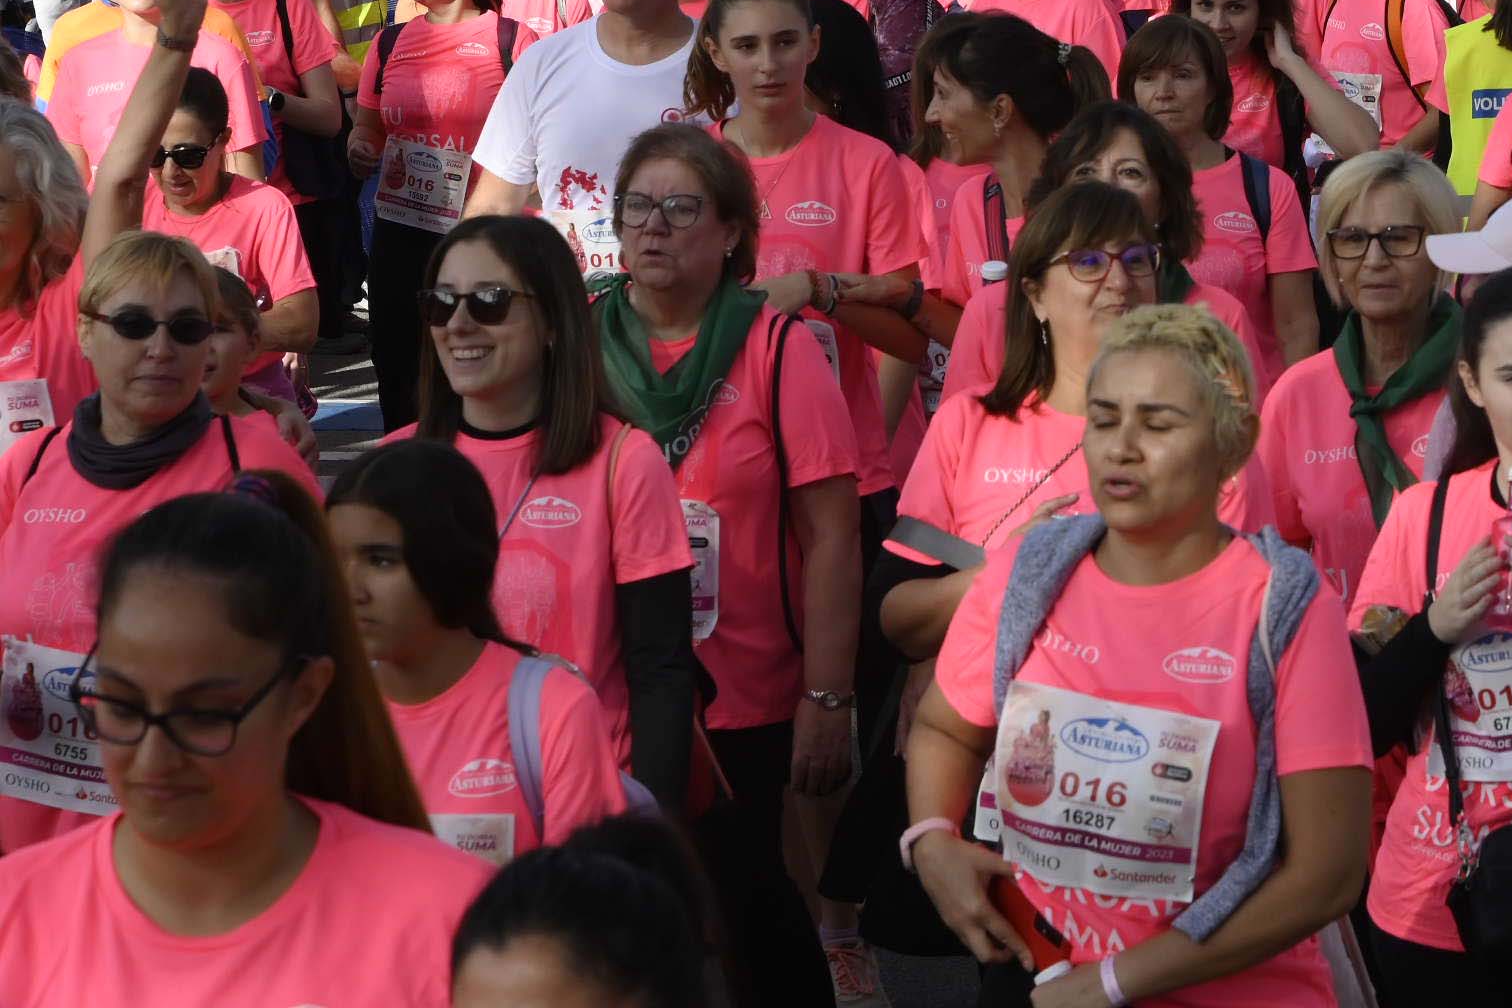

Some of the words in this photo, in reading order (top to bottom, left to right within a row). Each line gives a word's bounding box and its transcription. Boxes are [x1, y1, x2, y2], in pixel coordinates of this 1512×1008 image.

[382, 106, 402, 126] TU
[407, 174, 435, 193] 016
[788, 207, 835, 222] ASTURIANA
[8, 401, 40, 410] SUMA
[23, 508, 86, 523] OYSHO
[523, 510, 577, 521] ASTURIANA
[1168, 657, 1233, 678] ASTURIANA
[1068, 727, 1143, 756] ASTURIANA
[1158, 738, 1197, 754] SUMA
[1498, 737, 1512, 749] DE
[53, 742, 88, 762] 6755
[5, 772, 50, 793] OYSHO
[1059, 771, 1128, 808] 016
[1062, 807, 1116, 831] 16287
[456, 841, 497, 851] SUMA
[1065, 833, 1082, 846] DE
[1084, 836, 1099, 848] LA
[1100, 840, 1142, 858] MUJER
[1109, 867, 1177, 885] Santander
